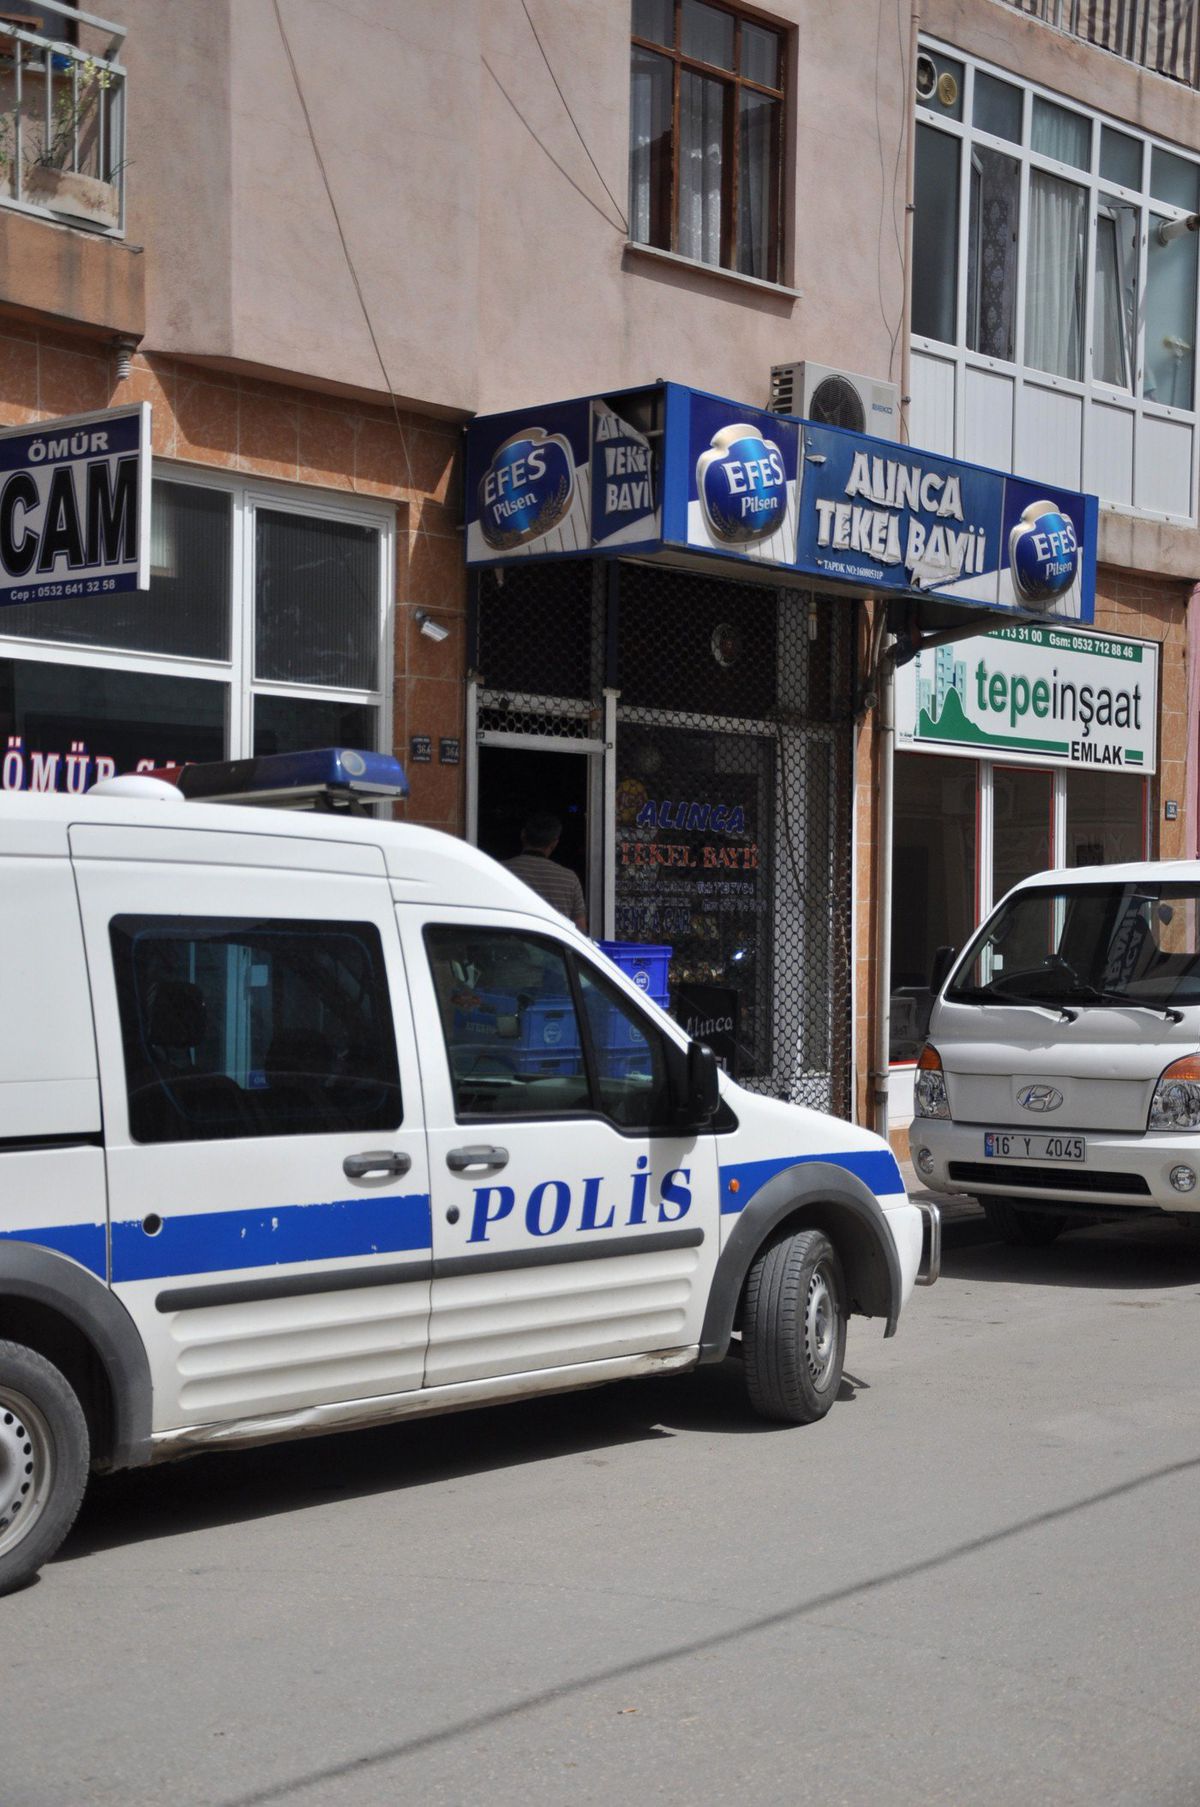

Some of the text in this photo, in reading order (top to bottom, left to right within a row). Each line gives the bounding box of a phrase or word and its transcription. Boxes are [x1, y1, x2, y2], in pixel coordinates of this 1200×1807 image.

[28, 432, 109, 462] ÖMÜR
[486, 449, 546, 504] EFES
[724, 454, 783, 494] EFES
[0, 454, 139, 577] CAM
[492, 491, 538, 525] Pilsen
[741, 493, 779, 517] Pilsen
[1034, 527, 1077, 560] EFES
[1045, 560, 1073, 580] Pilsen
[10, 589, 29, 601] Cep
[38, 584, 62, 597] 0532
[65, 582, 84, 595] 641
[87, 582, 100, 592] 32
[103, 579, 116, 591] 58
[1031, 630, 1043, 643] 00
[1049, 634, 1071, 648] Gsm:
[1072, 639, 1093, 653] 0532
[1094, 642, 1110, 655] 712
[1111, 645, 1122, 657] 88
[1123, 646, 1134, 658] 46
[975, 659, 1141, 737] tepeinşaat
[1071, 741, 1123, 765] EMLAK
[636, 800, 745, 834] ALINCA
[996, 1136, 1082, 1158] 16 Y 4045
[465, 1155, 692, 1243] POLİS
